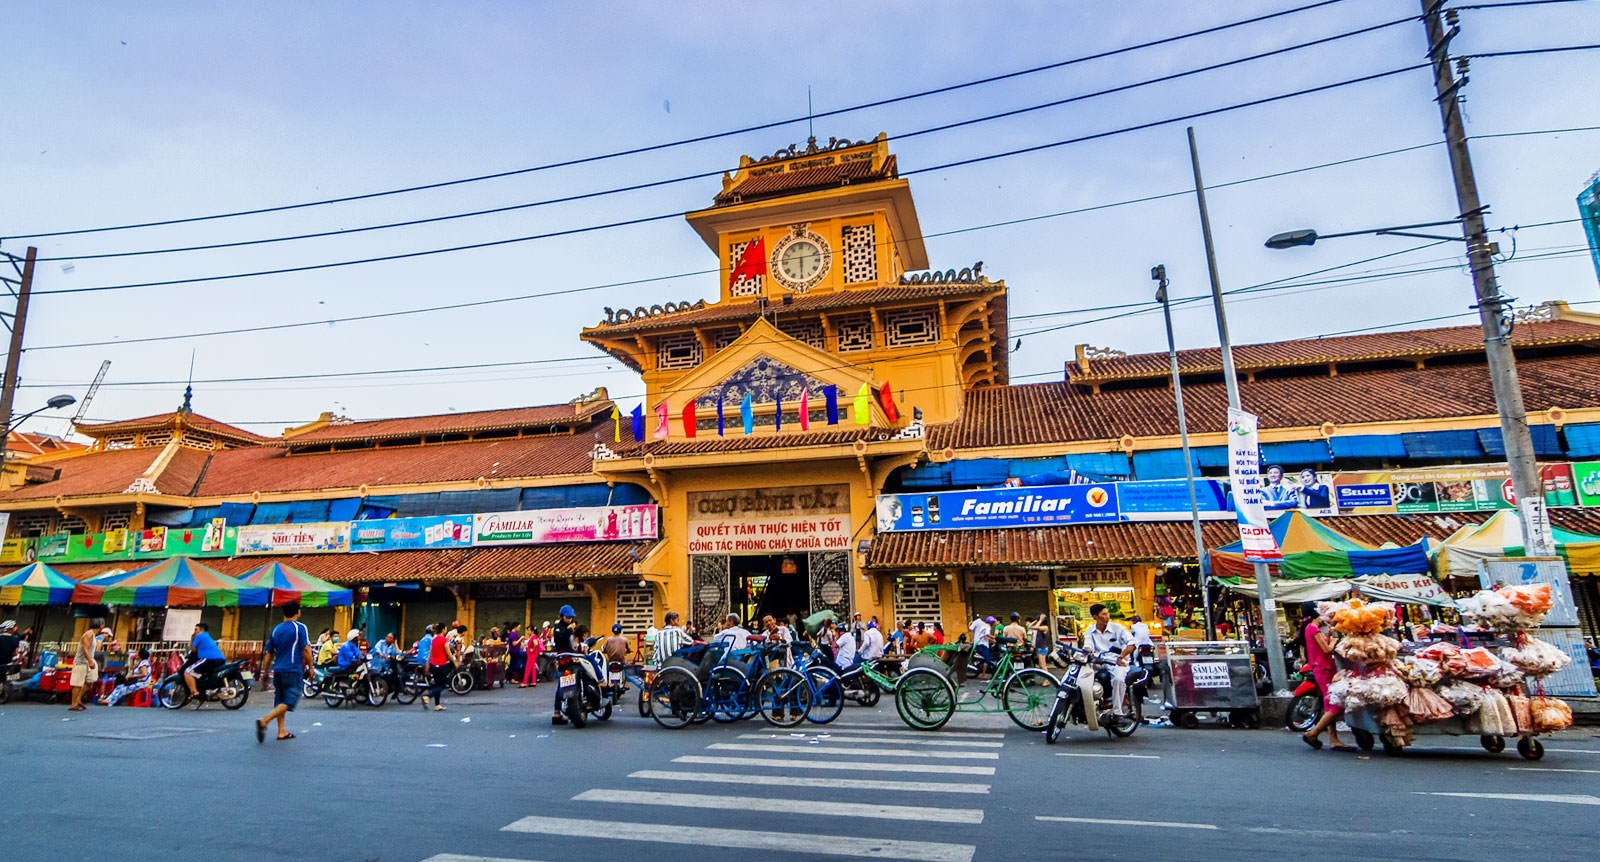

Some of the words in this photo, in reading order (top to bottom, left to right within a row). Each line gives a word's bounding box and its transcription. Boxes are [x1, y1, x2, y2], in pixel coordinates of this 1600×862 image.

[1341, 488, 1386, 496] SELLEYS
[698, 496, 737, 516] CHỢ
[961, 495, 1072, 516] Familiar
[489, 520, 533, 531] FAMILIAR
[697, 522, 730, 537] QUYẾT
[734, 522, 756, 535] TÂM
[760, 522, 788, 536] THỰC
[791, 520, 816, 534] HIỆN
[820, 518, 841, 532] TỐT
[690, 539, 712, 551] CÔNG
[716, 539, 733, 550] TÁC
[736, 538, 766, 550] PHÒNG
[769, 537, 793, 549] CHÁY
[796, 534, 821, 548] CHỮA
[824, 534, 848, 547] CHÁY
[1081, 572, 1097, 581] KIM
[1101, 572, 1128, 582] HẠNH
